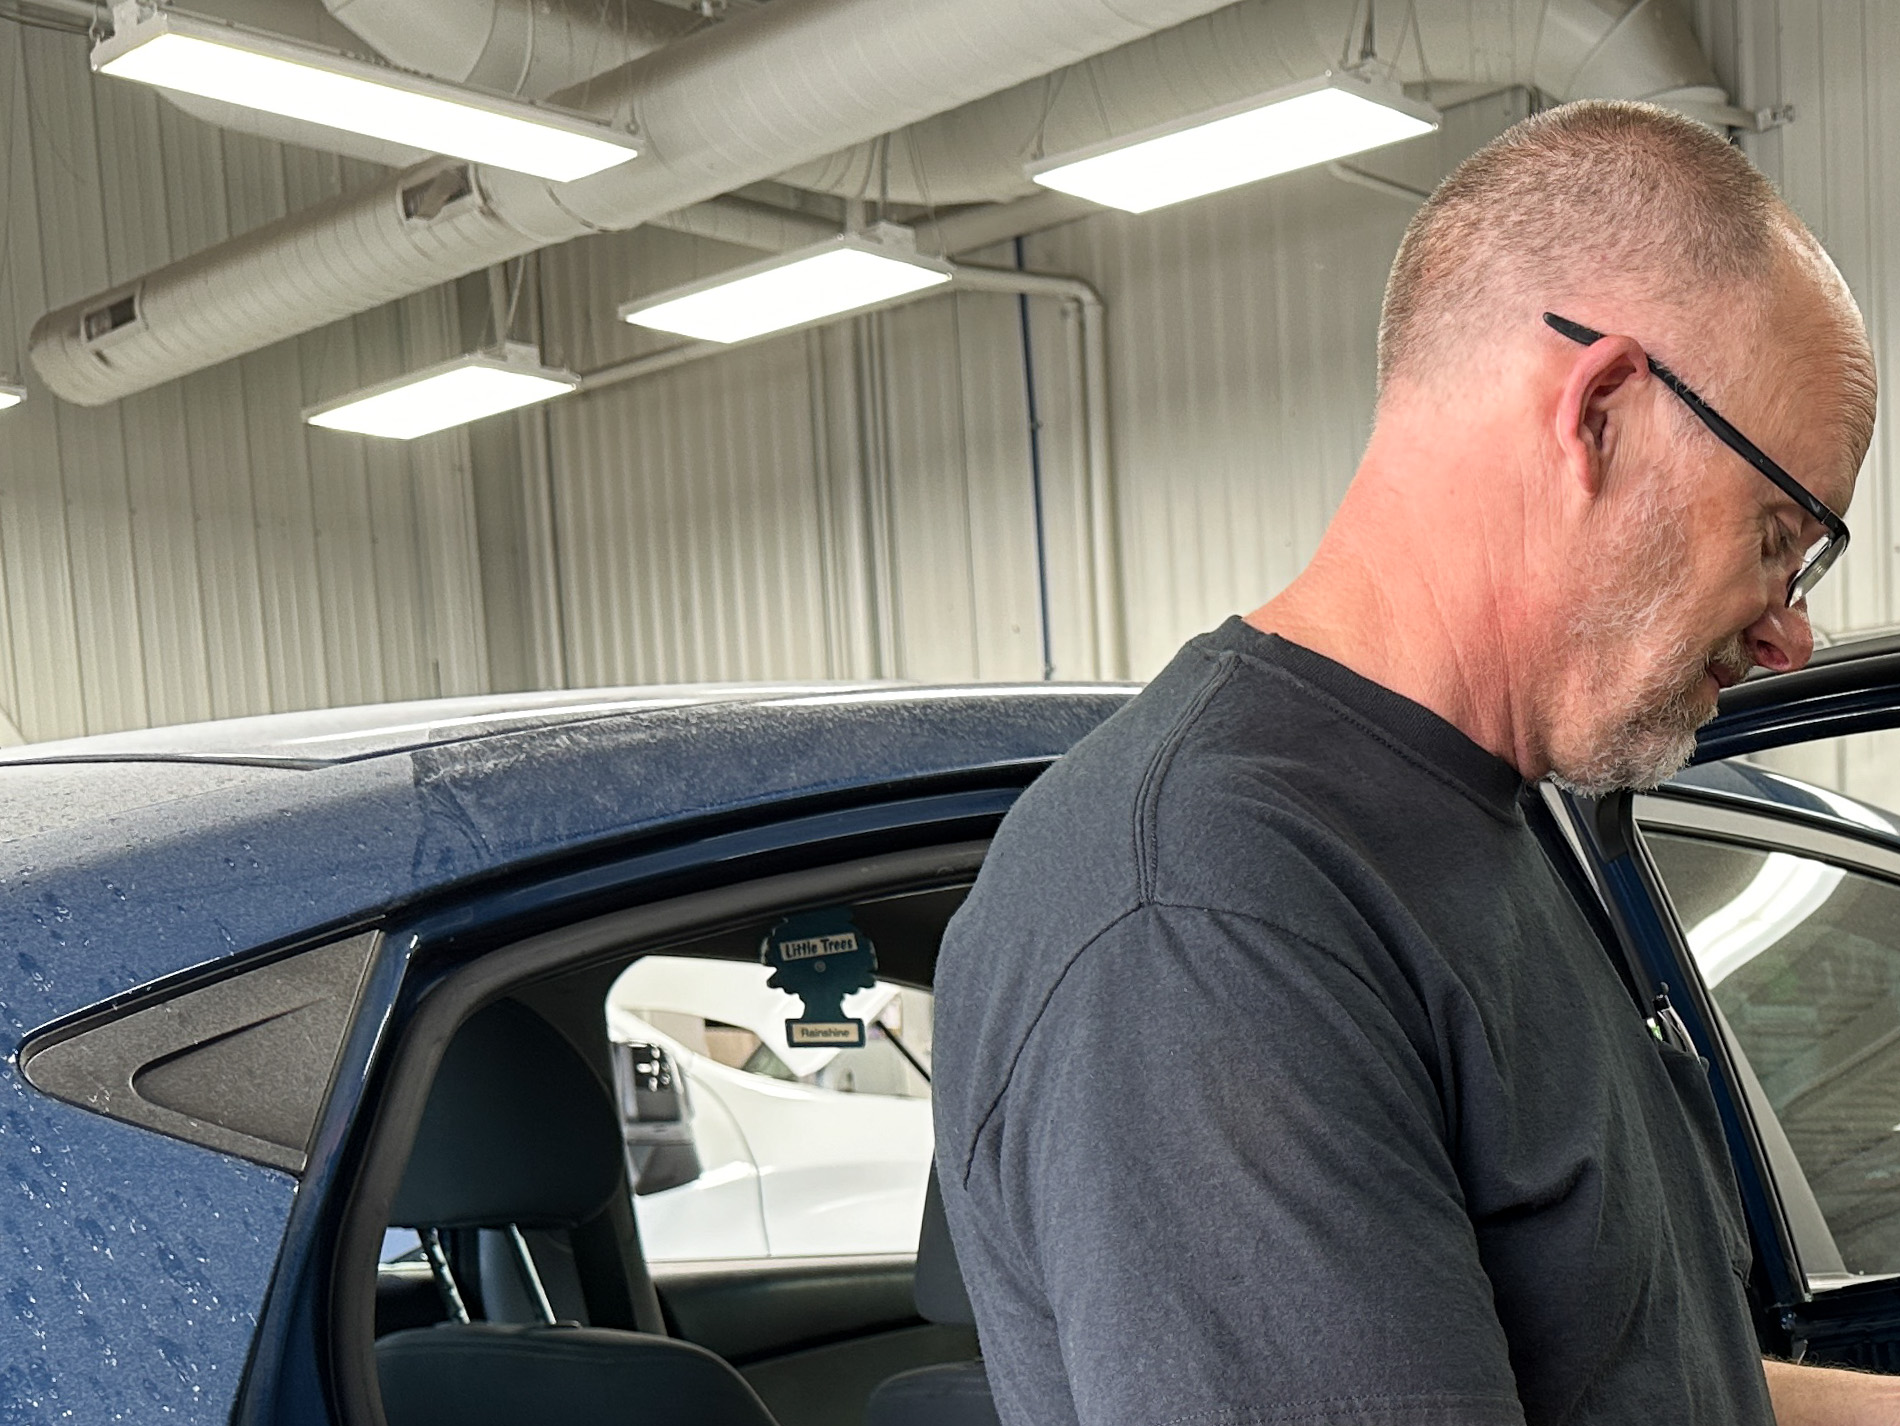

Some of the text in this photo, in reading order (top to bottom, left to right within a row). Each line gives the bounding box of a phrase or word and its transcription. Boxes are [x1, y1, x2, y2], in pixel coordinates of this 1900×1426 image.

[785, 938, 853, 958] Little Trees
[801, 1028, 849, 1038] Rainshine
